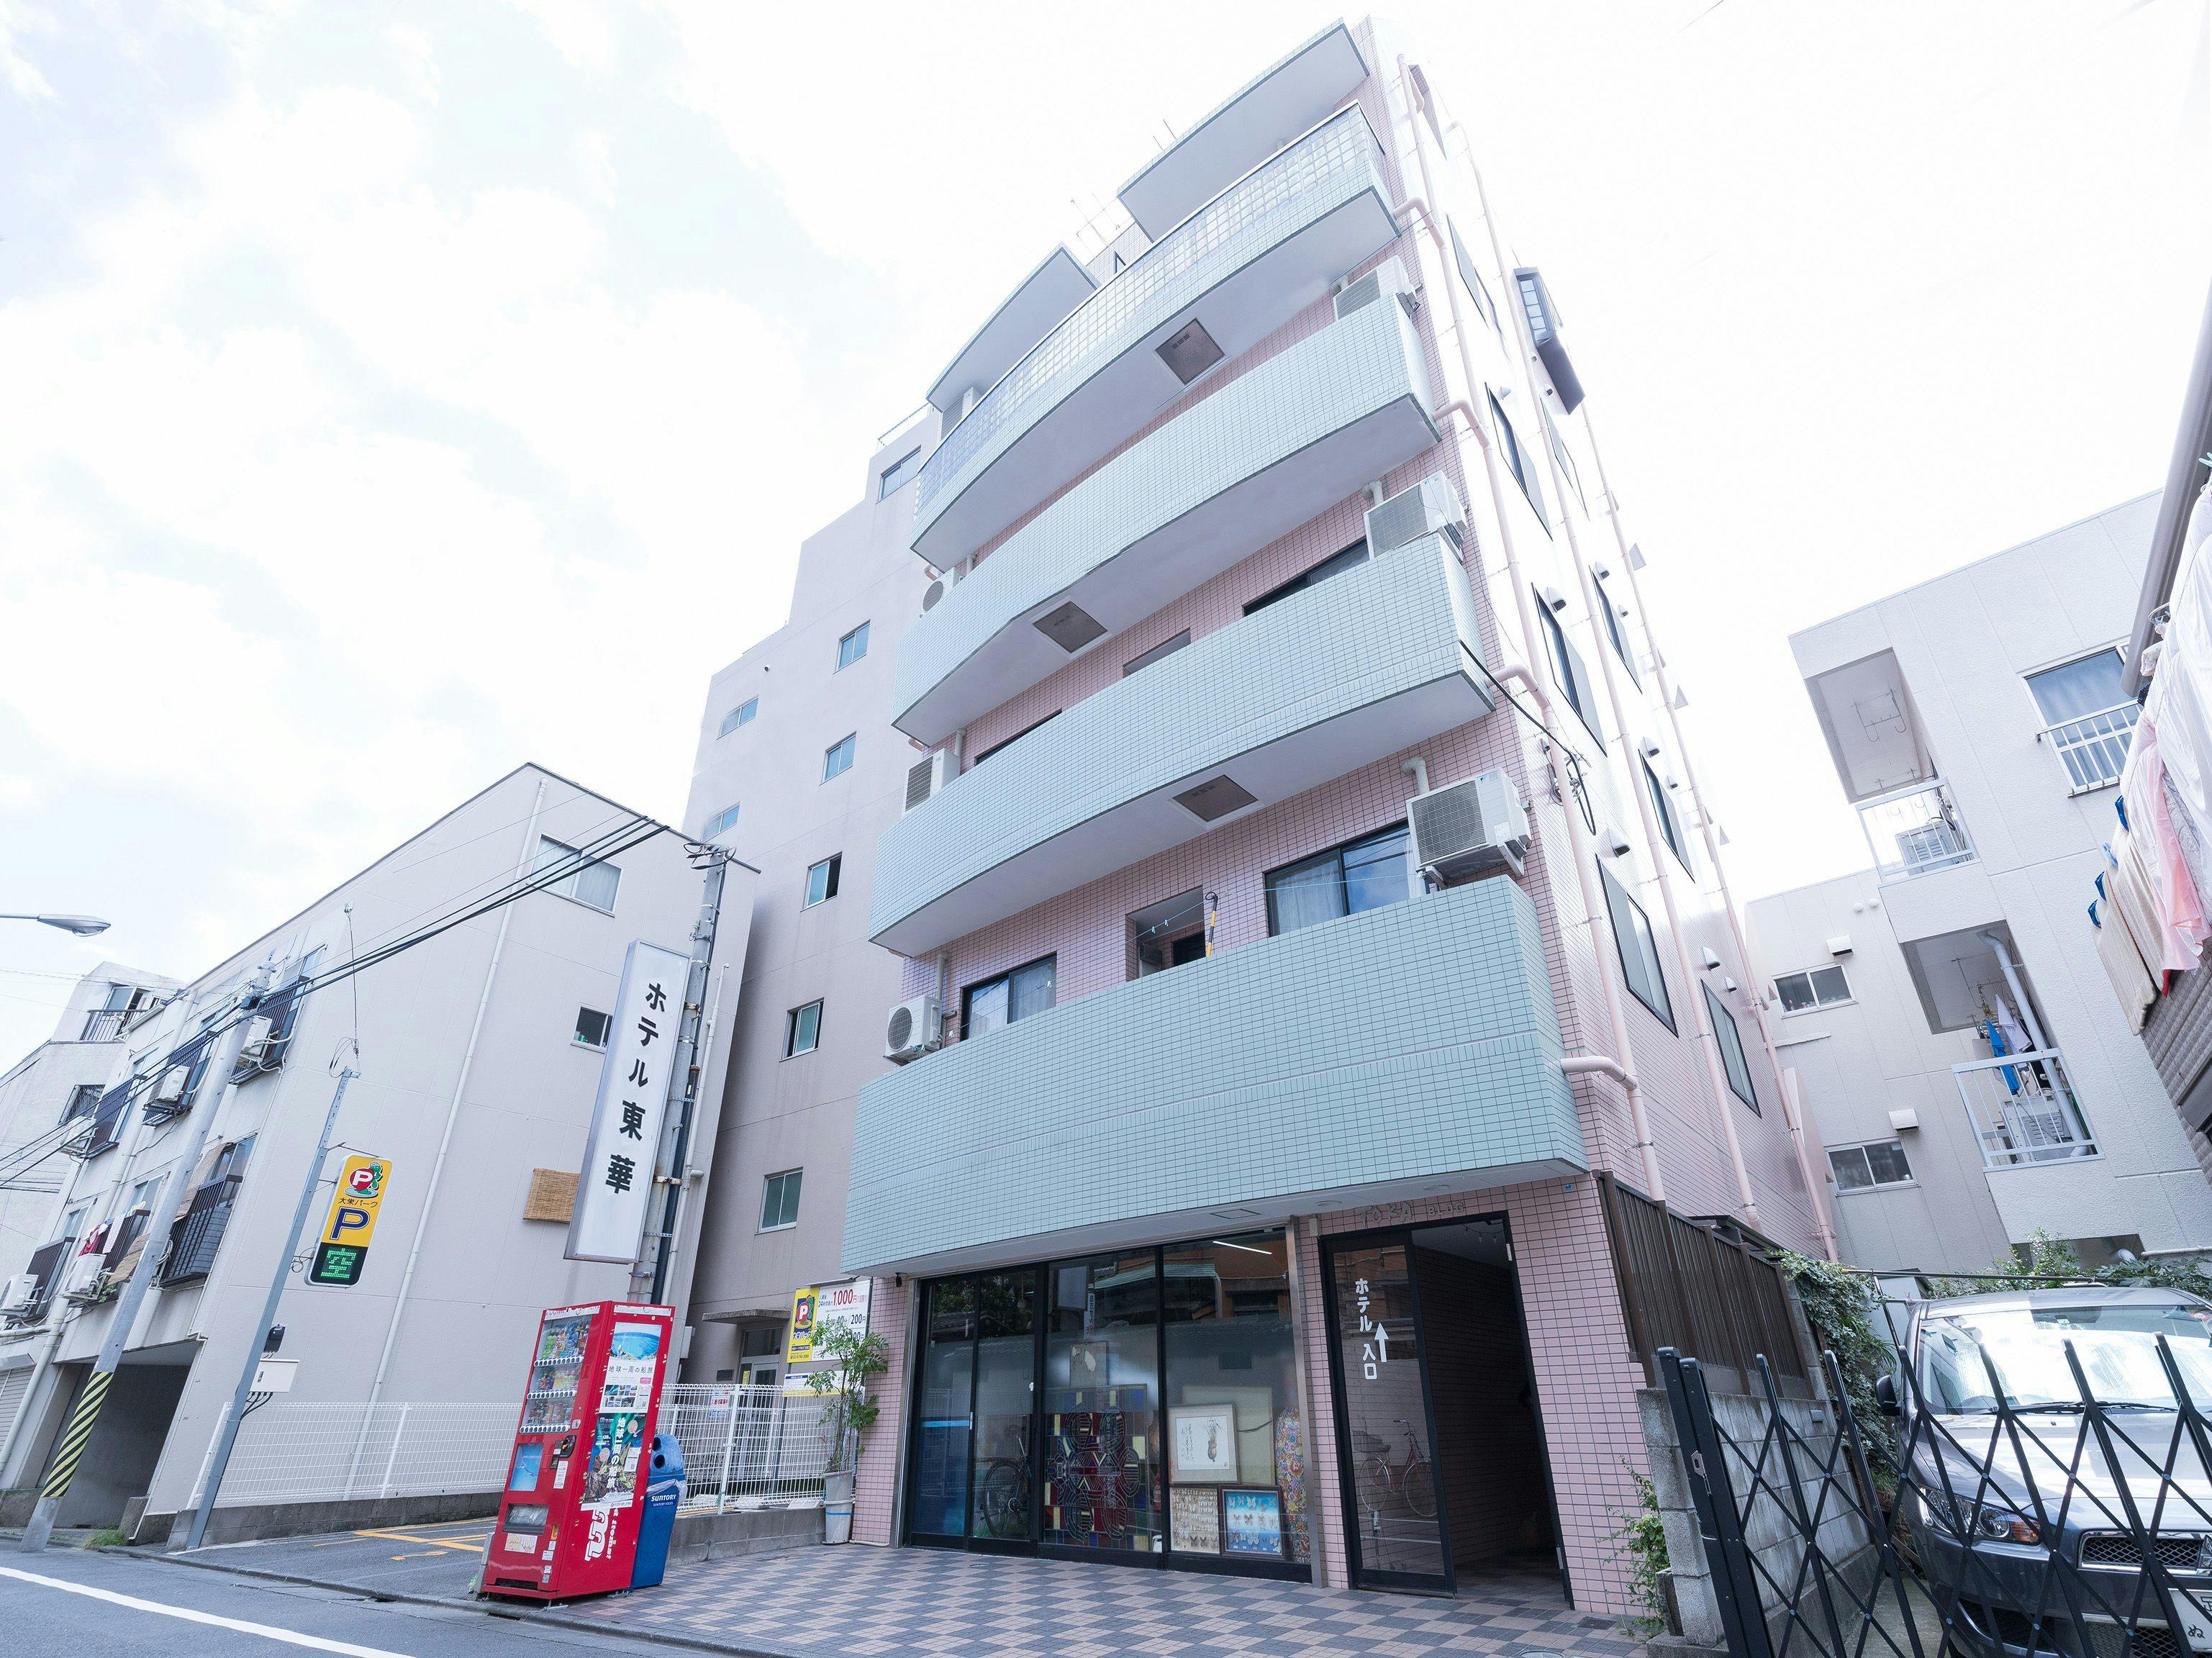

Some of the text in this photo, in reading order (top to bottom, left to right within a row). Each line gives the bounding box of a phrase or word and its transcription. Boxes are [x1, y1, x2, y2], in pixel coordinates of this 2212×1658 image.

[605, 982, 667, 1195] ホテル東華
[353, 1170, 373, 1187] P
[338, 1197, 379, 1208] 大栄パーク
[330, 1206, 371, 1241] P
[1355, 1200, 1465, 1228] TOKA BLDG
[321, 1248, 357, 1278] 空
[799, 1305, 809, 1320] P
[1355, 1278, 1377, 1380] ホテル 入口
[608, 1365, 653, 1374] 地球一周の船旅
[606, 1416, 627, 1489] 地球一周の船旅
[651, 1493, 677, 1502] SUNTORY
[2188, 1623, 2206, 1639] ぬ
